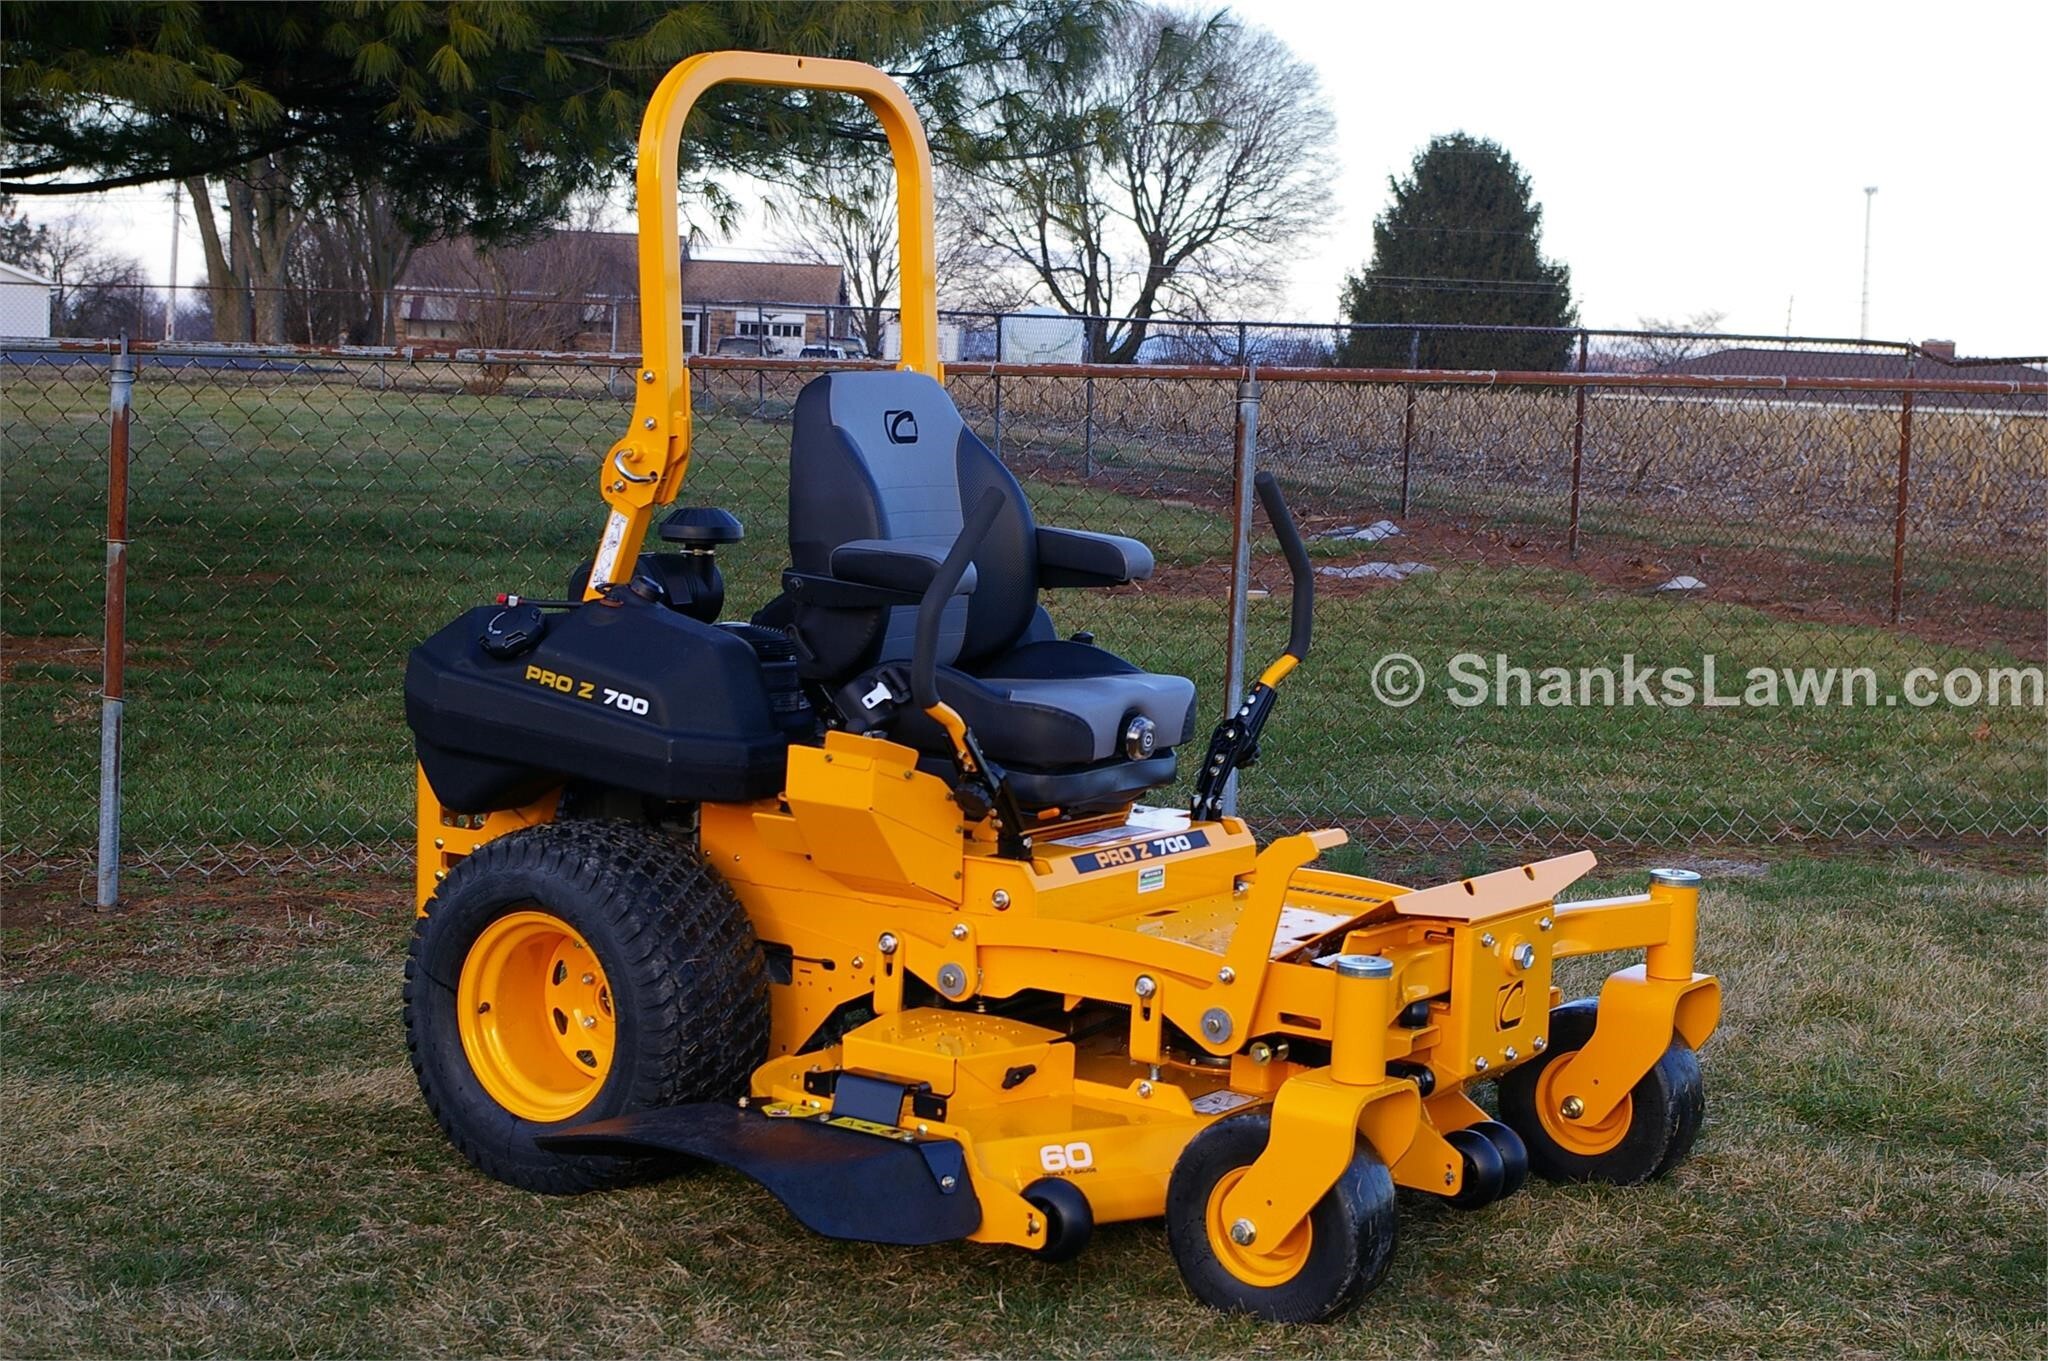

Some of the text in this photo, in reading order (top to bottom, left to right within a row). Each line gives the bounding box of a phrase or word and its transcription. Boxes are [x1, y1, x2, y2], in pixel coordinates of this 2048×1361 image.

[525, 665, 650, 715] PRO Z 700
[1094, 835, 1192, 868] PRO Z 700
[1040, 1142, 1094, 1172] 60
